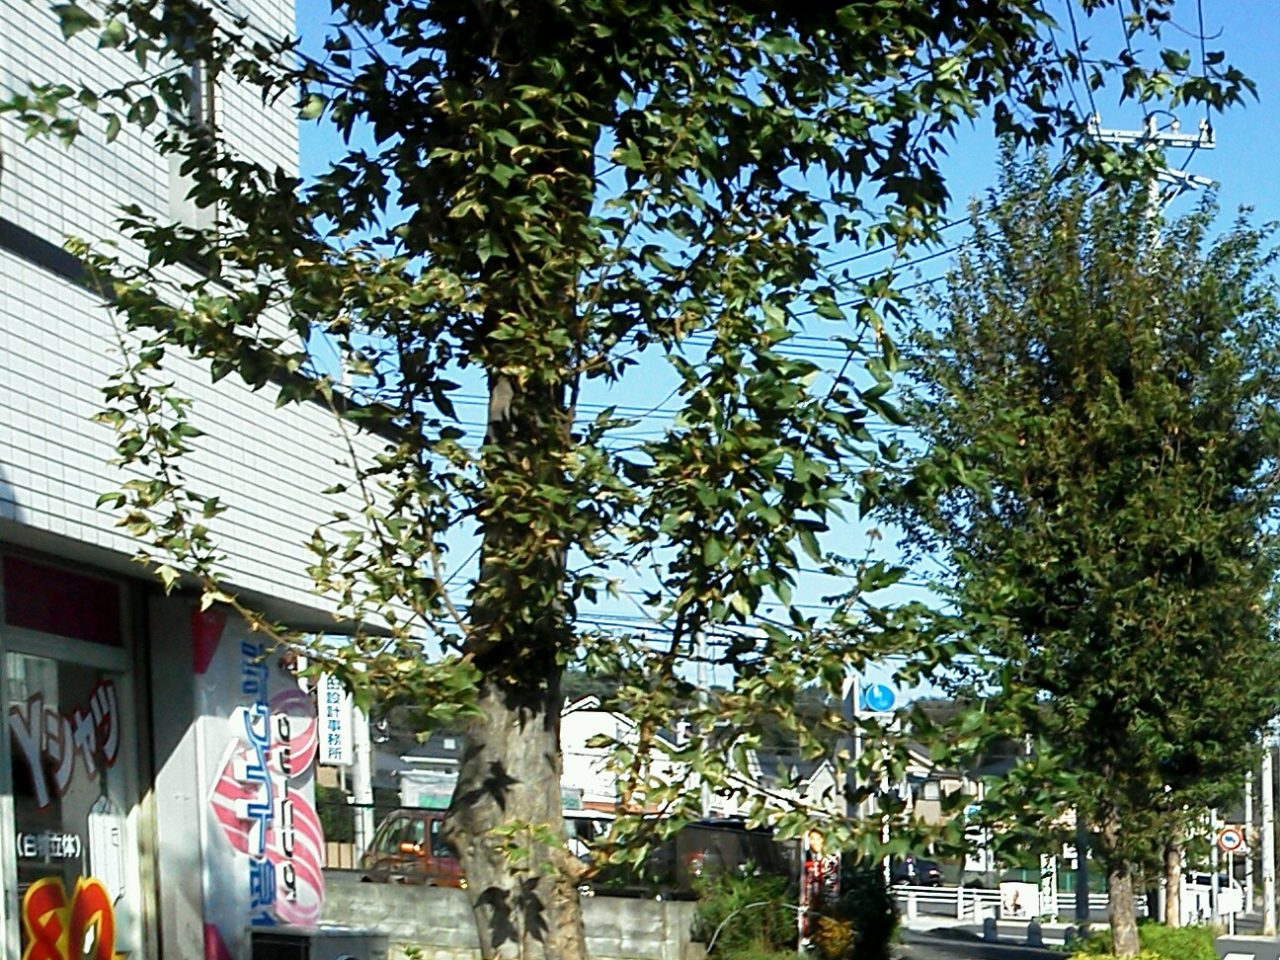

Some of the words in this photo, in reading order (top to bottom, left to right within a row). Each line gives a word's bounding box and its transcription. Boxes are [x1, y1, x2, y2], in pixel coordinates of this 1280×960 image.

[276, 714, 297, 900] クリーニング
